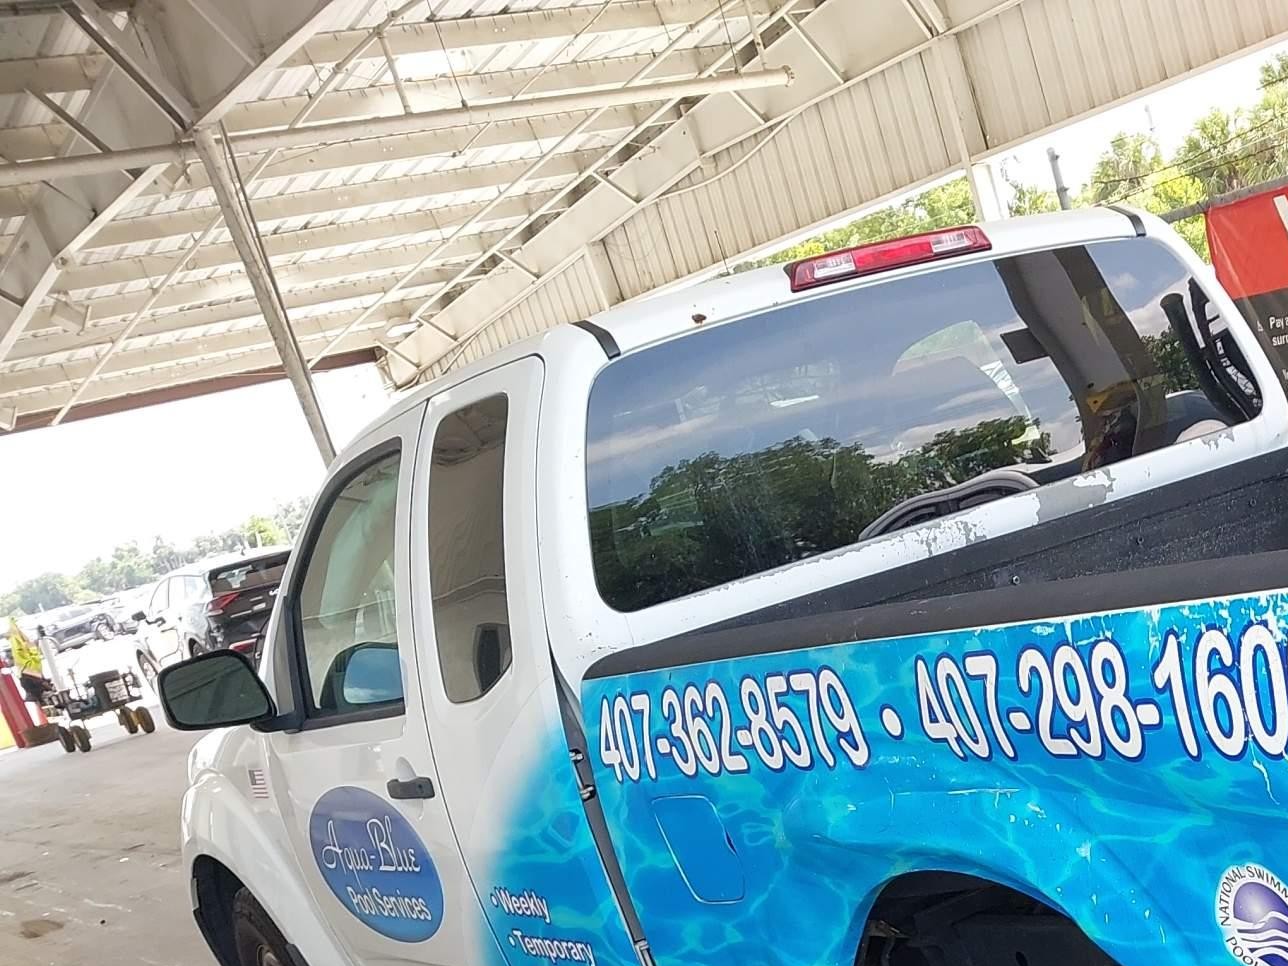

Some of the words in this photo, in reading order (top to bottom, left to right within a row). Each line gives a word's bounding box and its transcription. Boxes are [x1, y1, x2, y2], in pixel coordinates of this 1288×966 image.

[1269, 316, 1285, 330] Pay
[600, 666, 871, 783] 407-362-8579
[322, 816, 421, 889] Aqua-Blue
[346, 886, 375, 915] Pool
[373, 888, 432, 921] Services
[495, 886, 551, 924] Weekly
[1219, 866, 1246, 926] NATIONAL
